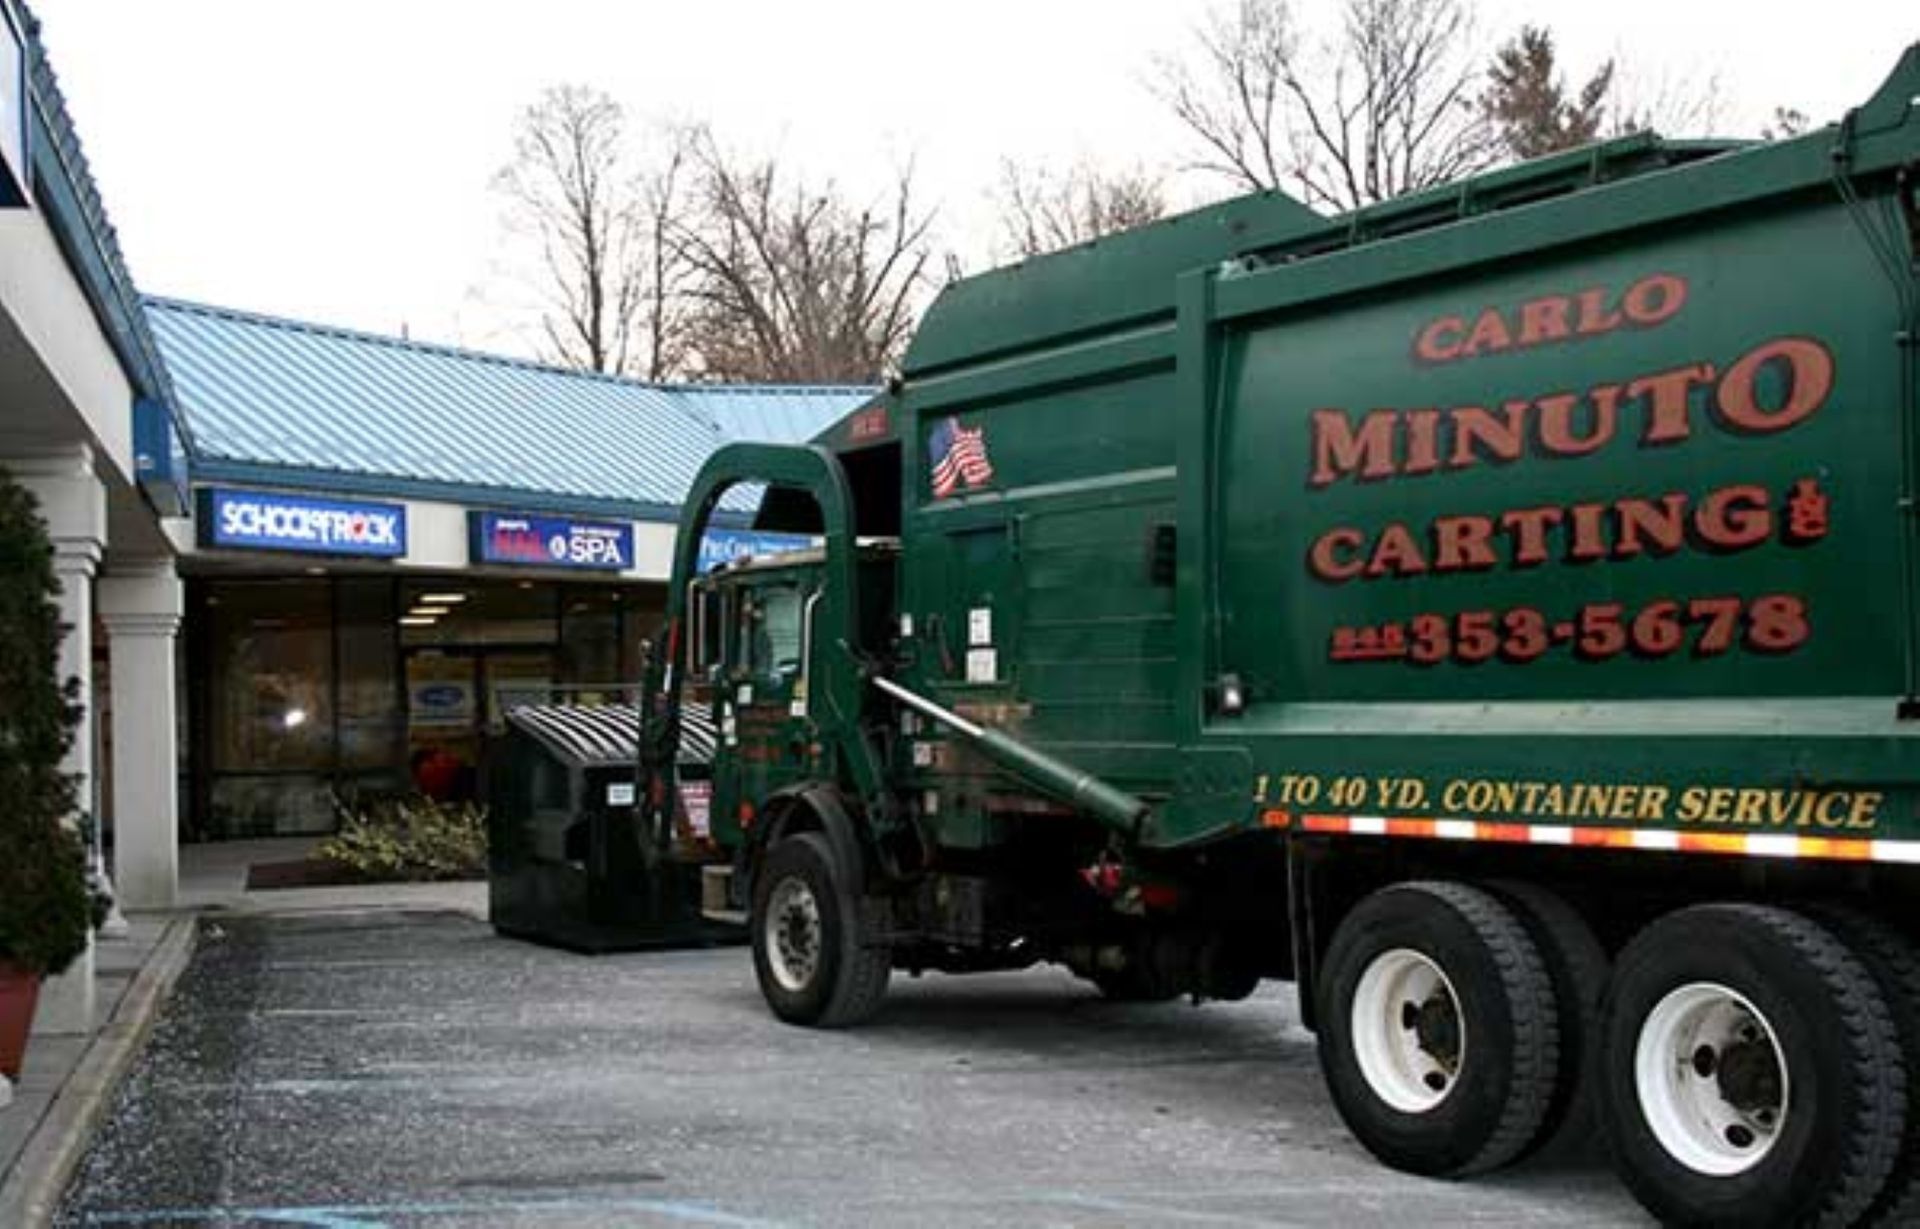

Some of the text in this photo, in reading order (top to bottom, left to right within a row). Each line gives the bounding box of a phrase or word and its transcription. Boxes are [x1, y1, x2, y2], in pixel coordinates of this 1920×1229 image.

[1414, 273, 1688, 361] CARLO
[1310, 338, 1834, 483] MINUTO
[570, 536, 623, 563] SPA
[1309, 485, 1772, 578] CARTING
[1252, 774, 1883, 828] 1 TO 40 YD. CONTAINER SERVICE
